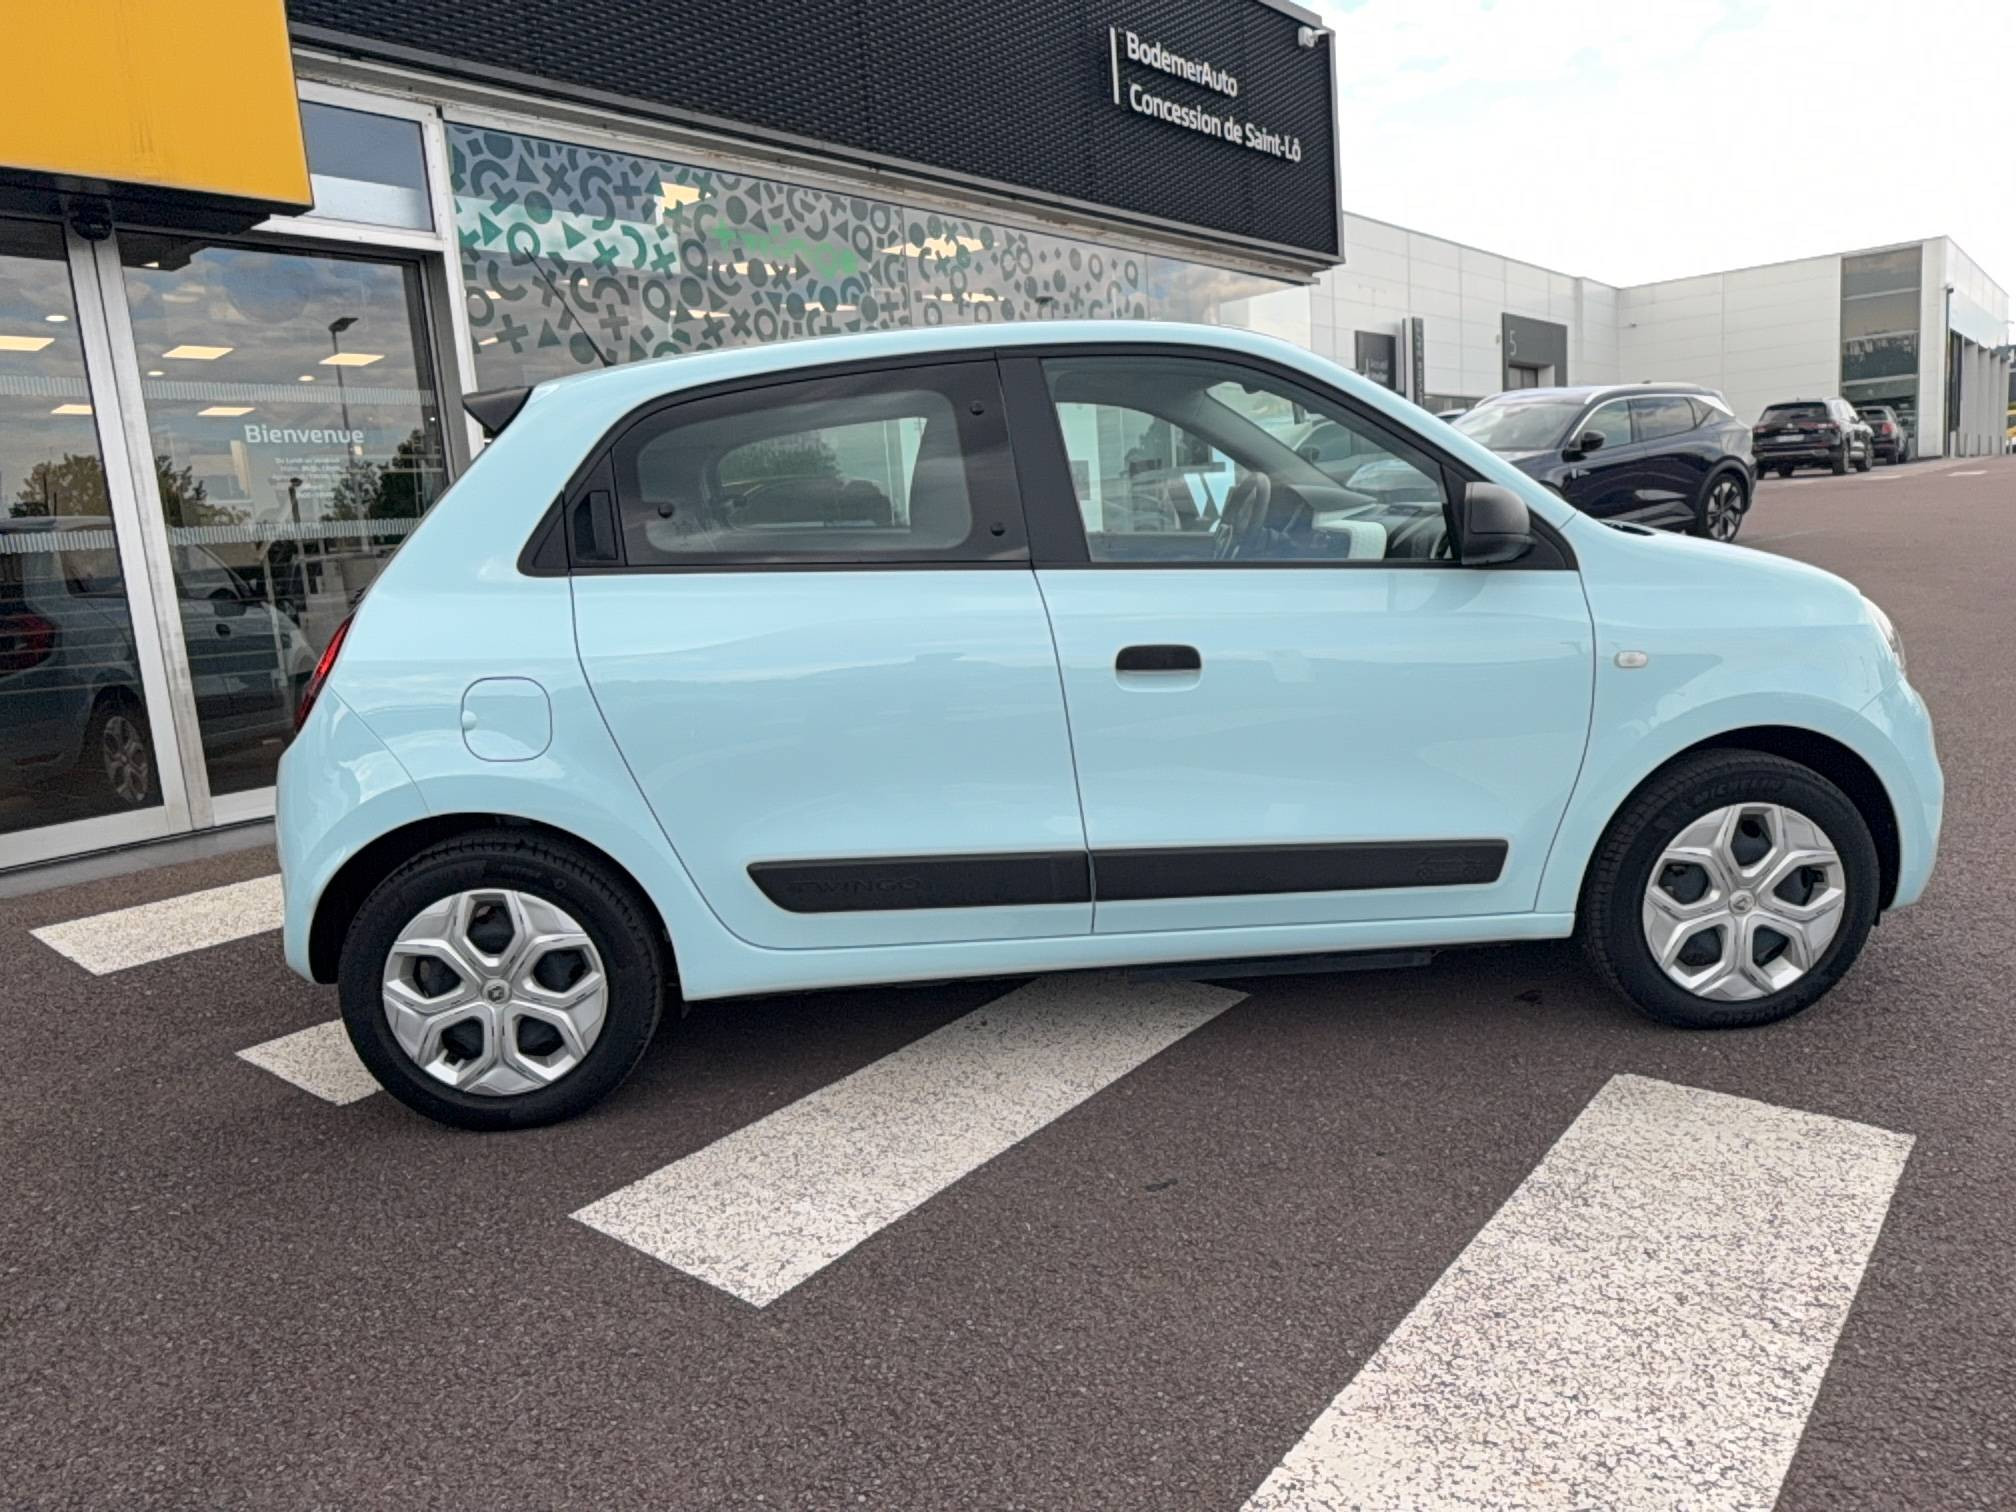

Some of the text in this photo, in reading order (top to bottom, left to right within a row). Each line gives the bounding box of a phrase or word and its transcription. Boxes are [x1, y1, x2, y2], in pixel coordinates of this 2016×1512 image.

[1125, 31, 1238, 97] BodemerAuto
[1129, 83, 1302, 162] Concession de Saint-Lô
[1508, 329, 1517, 357] 5
[244, 424, 365, 443] Bienvenue
